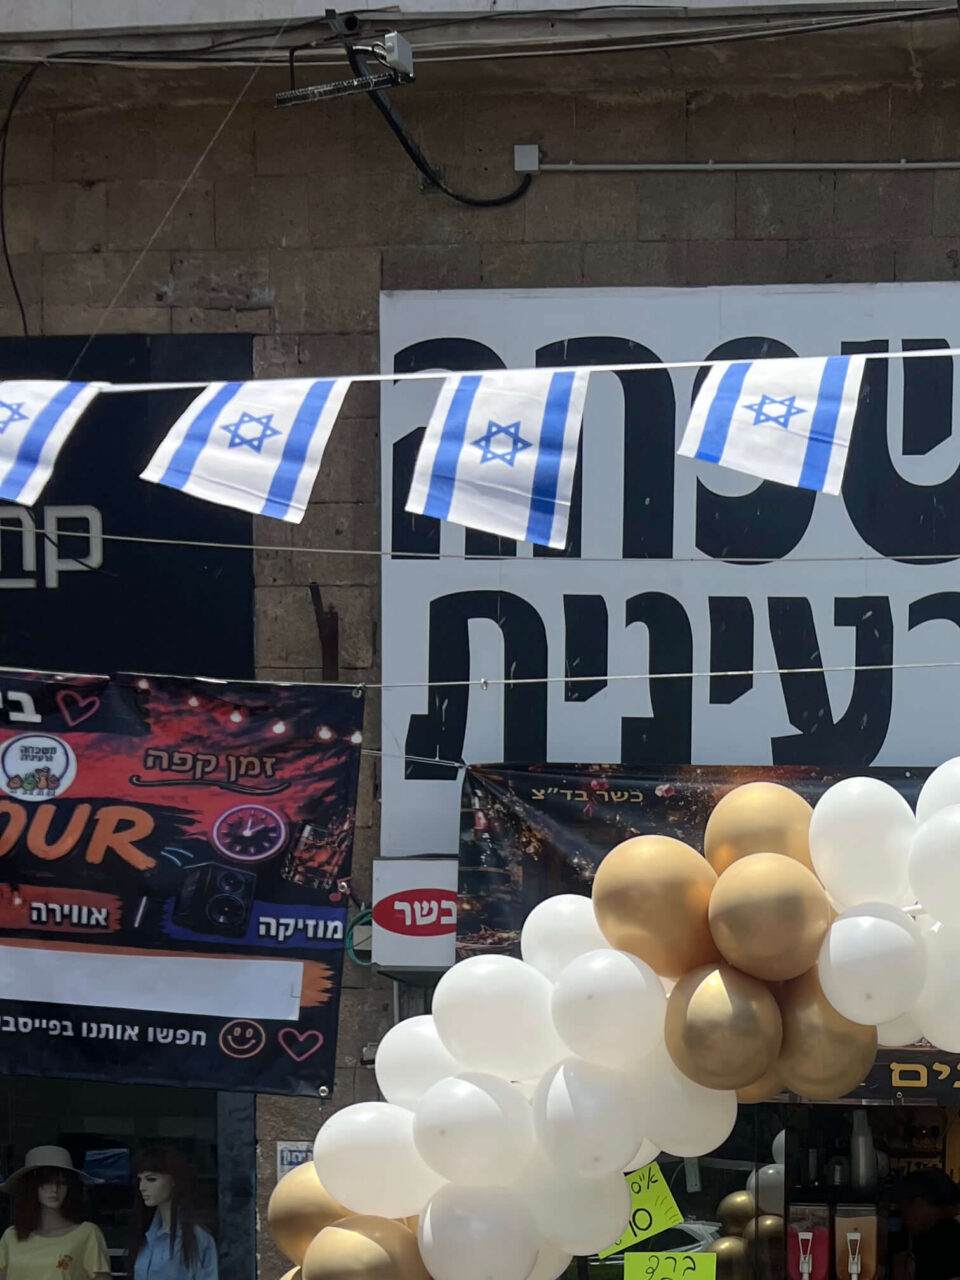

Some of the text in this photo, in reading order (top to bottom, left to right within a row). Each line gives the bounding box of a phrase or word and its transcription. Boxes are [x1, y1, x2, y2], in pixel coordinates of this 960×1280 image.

[144, 749, 277, 782] זמן קפה
[595, 789, 643, 803] כשר
[30, 902, 110, 928] אווירה
[393, 900, 458, 926] כשר
[258, 915, 345, 942] מוזיקה
[0, 1015, 207, 1047] חפשו אותנו בפייסב
